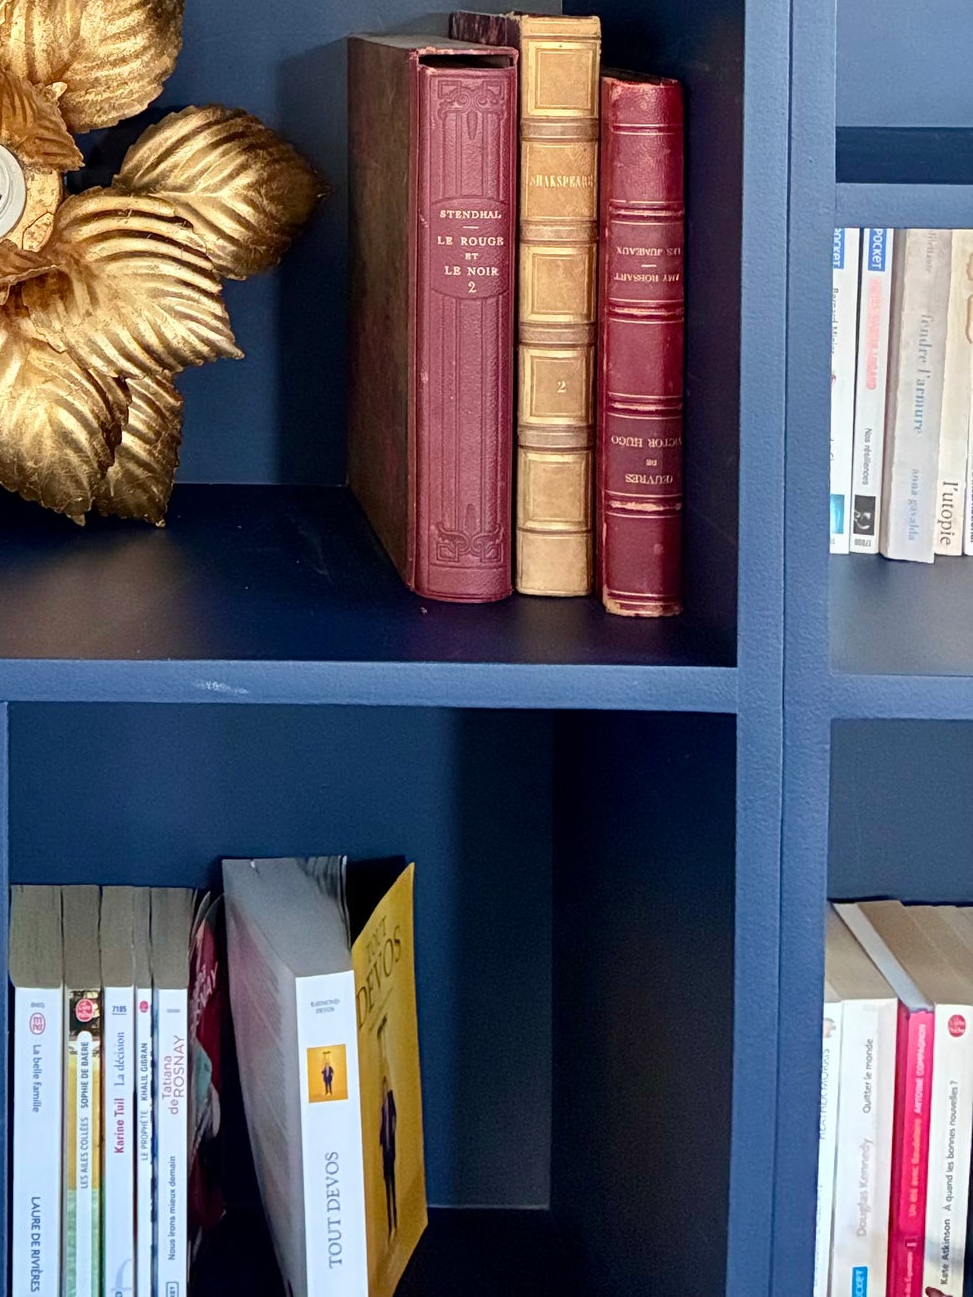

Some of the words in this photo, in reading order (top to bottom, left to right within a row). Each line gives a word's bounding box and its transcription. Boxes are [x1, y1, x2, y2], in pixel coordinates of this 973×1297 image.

[440, 209, 502, 220] STENDHAL
[437, 236, 454, 246] LE
[460, 236, 504, 247] ROUGE
[617, 247, 663, 256] JUMEAUX
[465, 253, 478, 261] ET
[444, 265, 461, 276] LE
[467, 265, 499, 276] NOIR
[468, 281, 477, 293] 2
[919, 314, 933, 364] fendre
[557, 380, 566, 393] 2
[913, 370, 931, 433] l'armure
[611, 435, 643, 448] HUGO
[861, 445, 870, 486] résiliences
[911, 468, 919, 496] anna
[937, 481, 958, 546] l'utopie
[356, 925, 401, 1030] DEVOS
[33, 1044, 41, 1057] La
[80, 1042, 89, 1064] BAERE
[115, 1031, 125, 1072] décision
[864, 1039, 874, 1071] monde
[33, 1059, 43, 1082] belle
[80, 1067, 88, 1078] DE
[162, 1055, 172, 1100] Tatiana
[174, 1035, 185, 1098] ROSNAY
[864, 1073, 872, 1081] le
[115, 1074, 125, 1087] La
[32, 1083, 43, 1113] famille
[80, 1081, 88, 1109] SOPHIE
[115, 1098, 124, 1118] Tuil
[170, 1099, 179, 1115] de
[863, 1082, 872, 1114] Quitter
[949, 1087, 958, 1126] nouvelles
[80, 1117, 89, 1146] COLLÉES
[115, 1120, 124, 1154] Karine
[948, 1129, 956, 1160] bonnes
[80, 1148, 88, 1170] AILES
[141, 1150, 148, 1161] LE
[859, 1138, 875, 1189] Kennedy
[80, 1174, 88, 1189] LES
[168, 1155, 176, 1186] demain
[326, 1151, 341, 1213] DEVOS
[168, 1188, 176, 1212] mieux
[946, 1179, 954, 1204] quand
[31, 1196, 41, 1232] LAURE
[168, 1215, 176, 1237] irons
[857, 1190, 869, 1237] Douglas
[31, 1234, 41, 1247] DE
[168, 1240, 176, 1261] Nous
[329, 1218, 343, 1269] TOUT
[941, 1218, 951, 1260] Atkinson
[31, 1249, 42, 1292] RIVIÈRES
[940, 1262, 949, 1286] Kate
